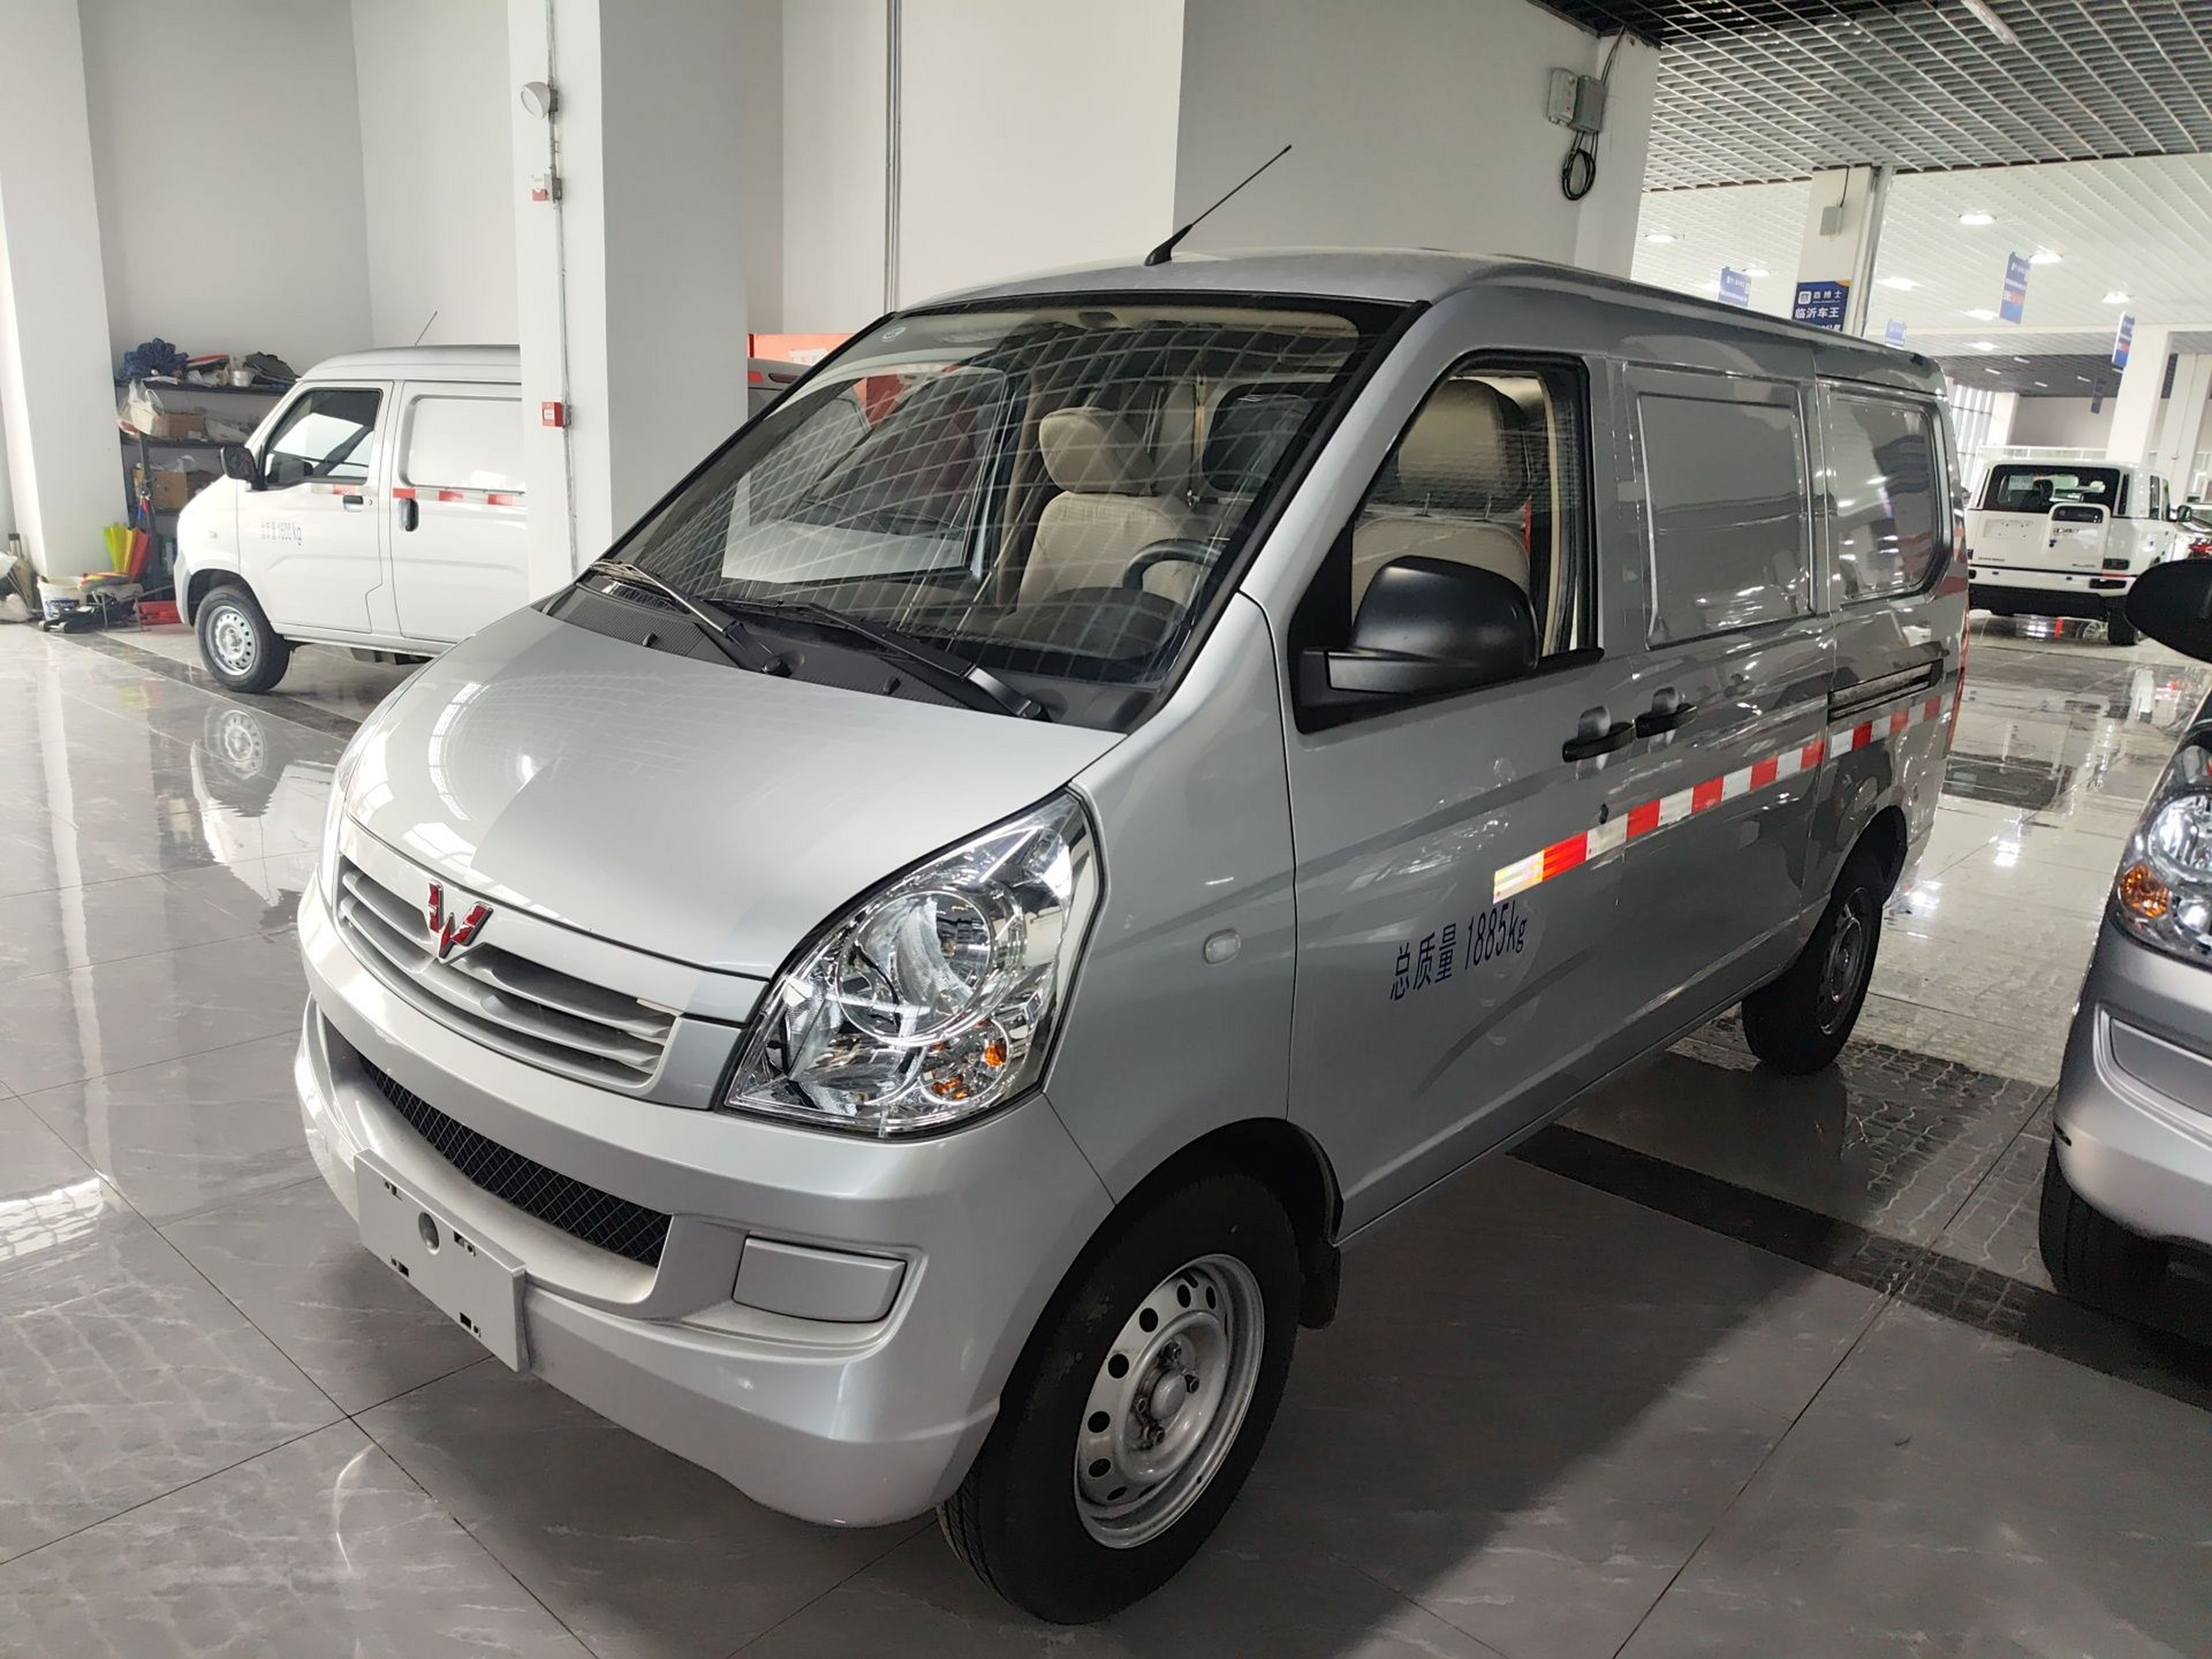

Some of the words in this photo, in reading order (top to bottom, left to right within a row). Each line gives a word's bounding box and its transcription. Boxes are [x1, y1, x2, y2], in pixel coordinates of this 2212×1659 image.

[1794, 307, 1840, 319] 临沂车王
[1390, 923, 1457, 1001] 总质量
[1465, 900, 1527, 969] 1885kg
